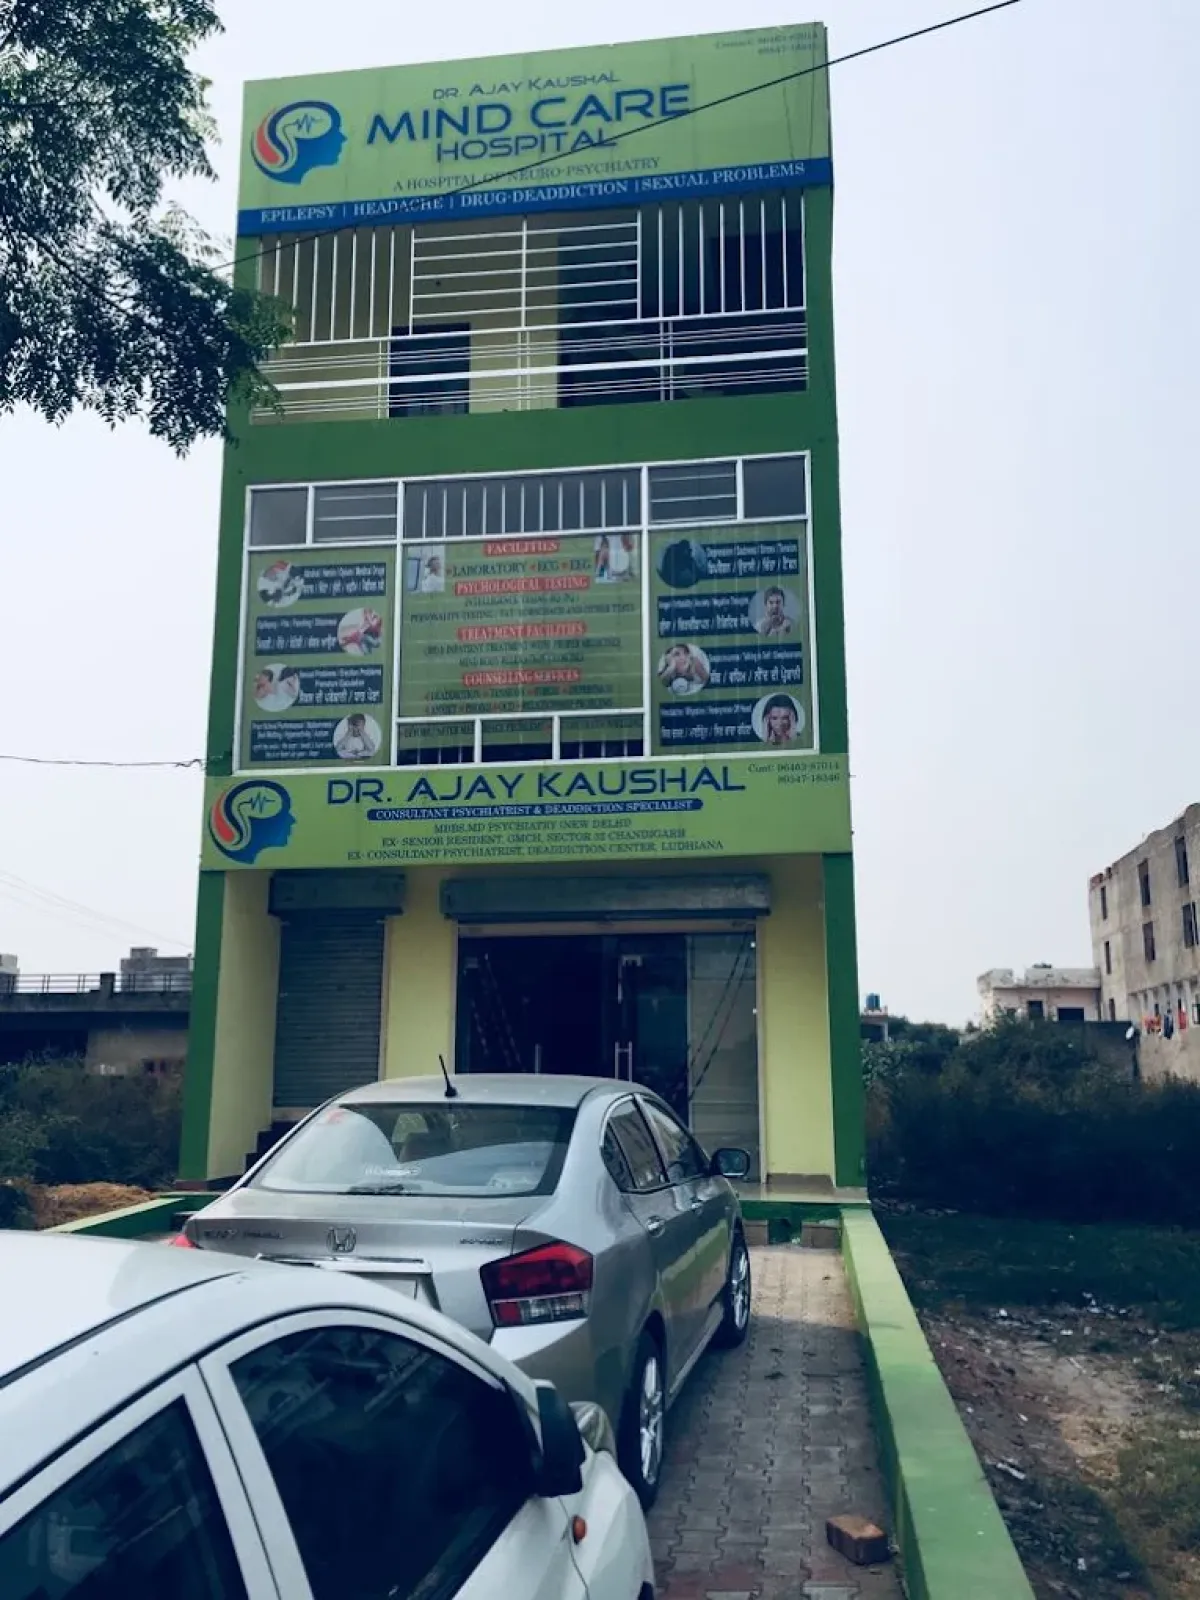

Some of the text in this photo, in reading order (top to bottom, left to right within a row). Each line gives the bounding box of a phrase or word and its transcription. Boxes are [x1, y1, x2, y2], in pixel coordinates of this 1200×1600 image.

[433, 70, 622, 100] DR. AJAY KAUSHAL
[367, 84, 691, 145] MIND CARE
[436, 128, 618, 164] HOSPITAL
[261, 204, 337, 223] EPILEPSY
[353, 195, 443, 217] HEADACHE
[641, 171, 710, 192] SEXUAL
[712, 161, 806, 186] PROBLEMS
[393, 181, 404, 192] A
[407, 174, 476, 191] HOSPITAL
[453, 561, 527, 577] LABORATORY
[457, 577, 539, 595] PSYCHOLOGICAL
[460, 622, 584, 641] TREATMENT FACILITIES
[327, 779, 393, 804] DR.
[407, 772, 524, 802] AJAY
[537, 766, 746, 797] KAUSHAL
[375, 799, 693, 820] CONSULTANT PSYCHIATRIST & DEADDICTION SPECIALIST
[488, 819, 558, 832] PSYCHIATRY
[402, 836, 444, 847] SENIOR
[547, 832, 591, 843] SECTOR
[607, 828, 686, 841] CHANDIGARH
[367, 848, 440, 860] CONSULTANT
[528, 844, 607, 856] DEADDICTION
[661, 840, 724, 852] LUDHIANA
